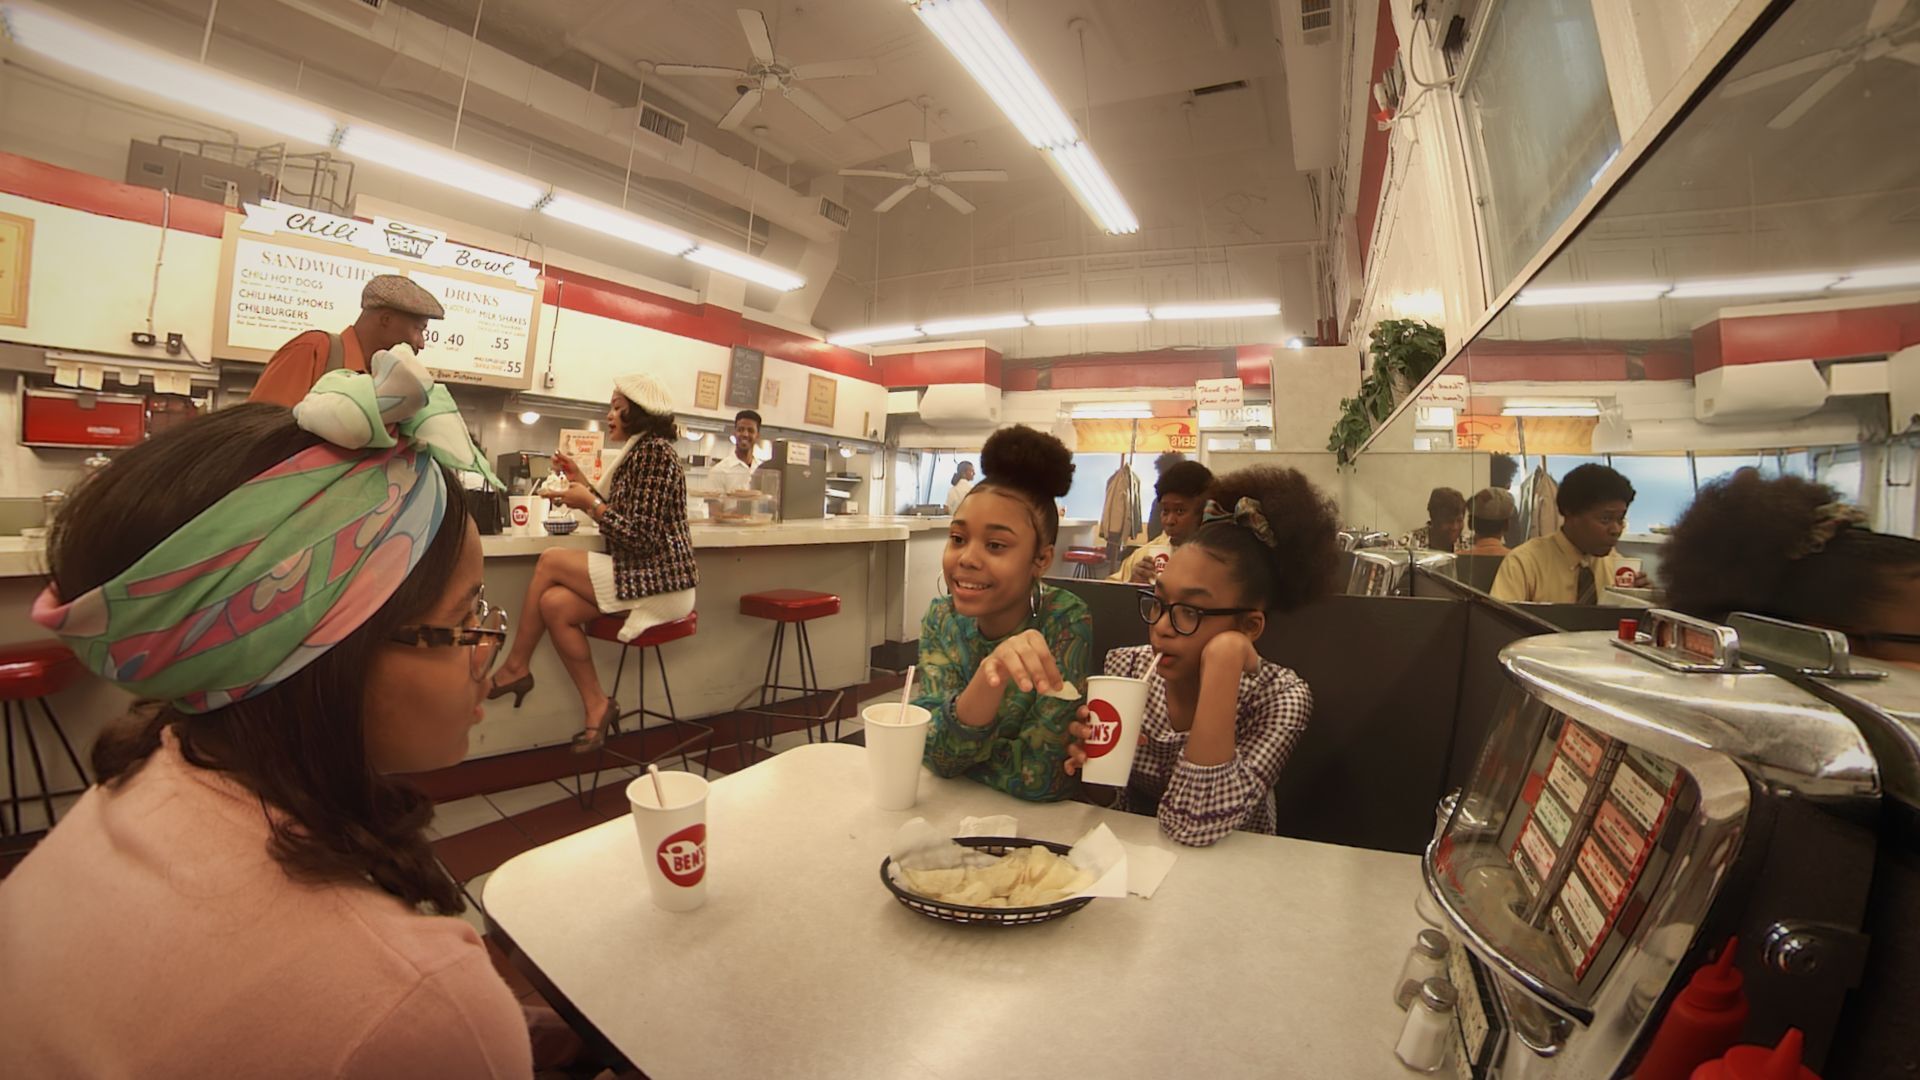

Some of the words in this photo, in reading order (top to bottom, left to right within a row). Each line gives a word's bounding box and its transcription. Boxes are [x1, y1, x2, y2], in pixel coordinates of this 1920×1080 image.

[286, 213, 358, 242] Chili
[455, 249, 514, 276] Bowl
[241, 268, 267, 281] CHILI
[270, 274, 292, 284] HOT
[295, 277, 323, 290] DOGS
[239, 288, 265, 300] CHILI
[268, 294, 293, 305] HALF
[296, 297, 334, 310] SMOKES
[444, 287, 500, 307] DRINKS
[237, 302, 309, 320] CHILIBURGERS
[443, 333, 464, 347] .40
[490, 337, 509, 350] .55
[503, 360, 521, 374] .55
